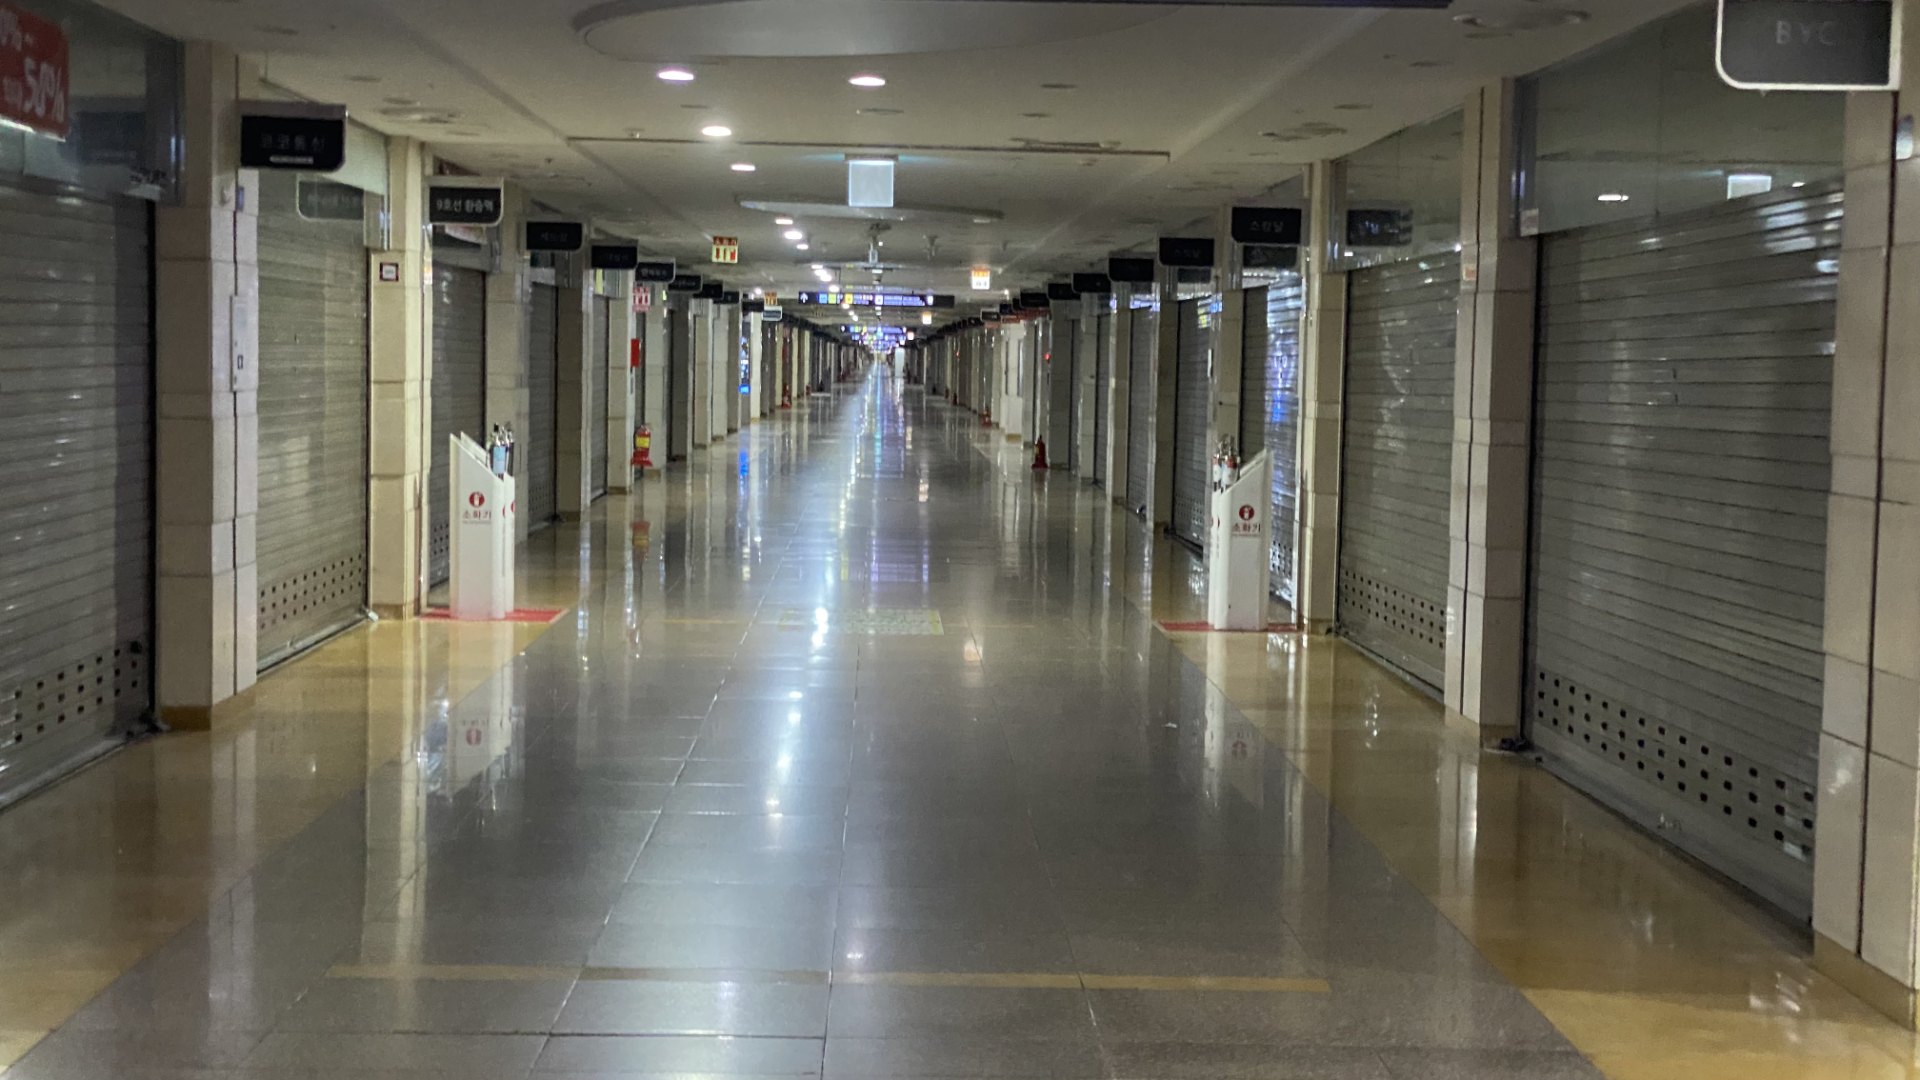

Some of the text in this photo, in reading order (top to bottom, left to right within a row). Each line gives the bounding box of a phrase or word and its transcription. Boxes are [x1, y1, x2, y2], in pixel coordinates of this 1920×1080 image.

[1776, 20, 1835, 46] BYC
[23, 55, 65, 122] 50%
[436, 198, 494, 213] 9호선 환승역
[463, 509, 492, 520] 소화기
[1232, 522, 1261, 533] 소화기
